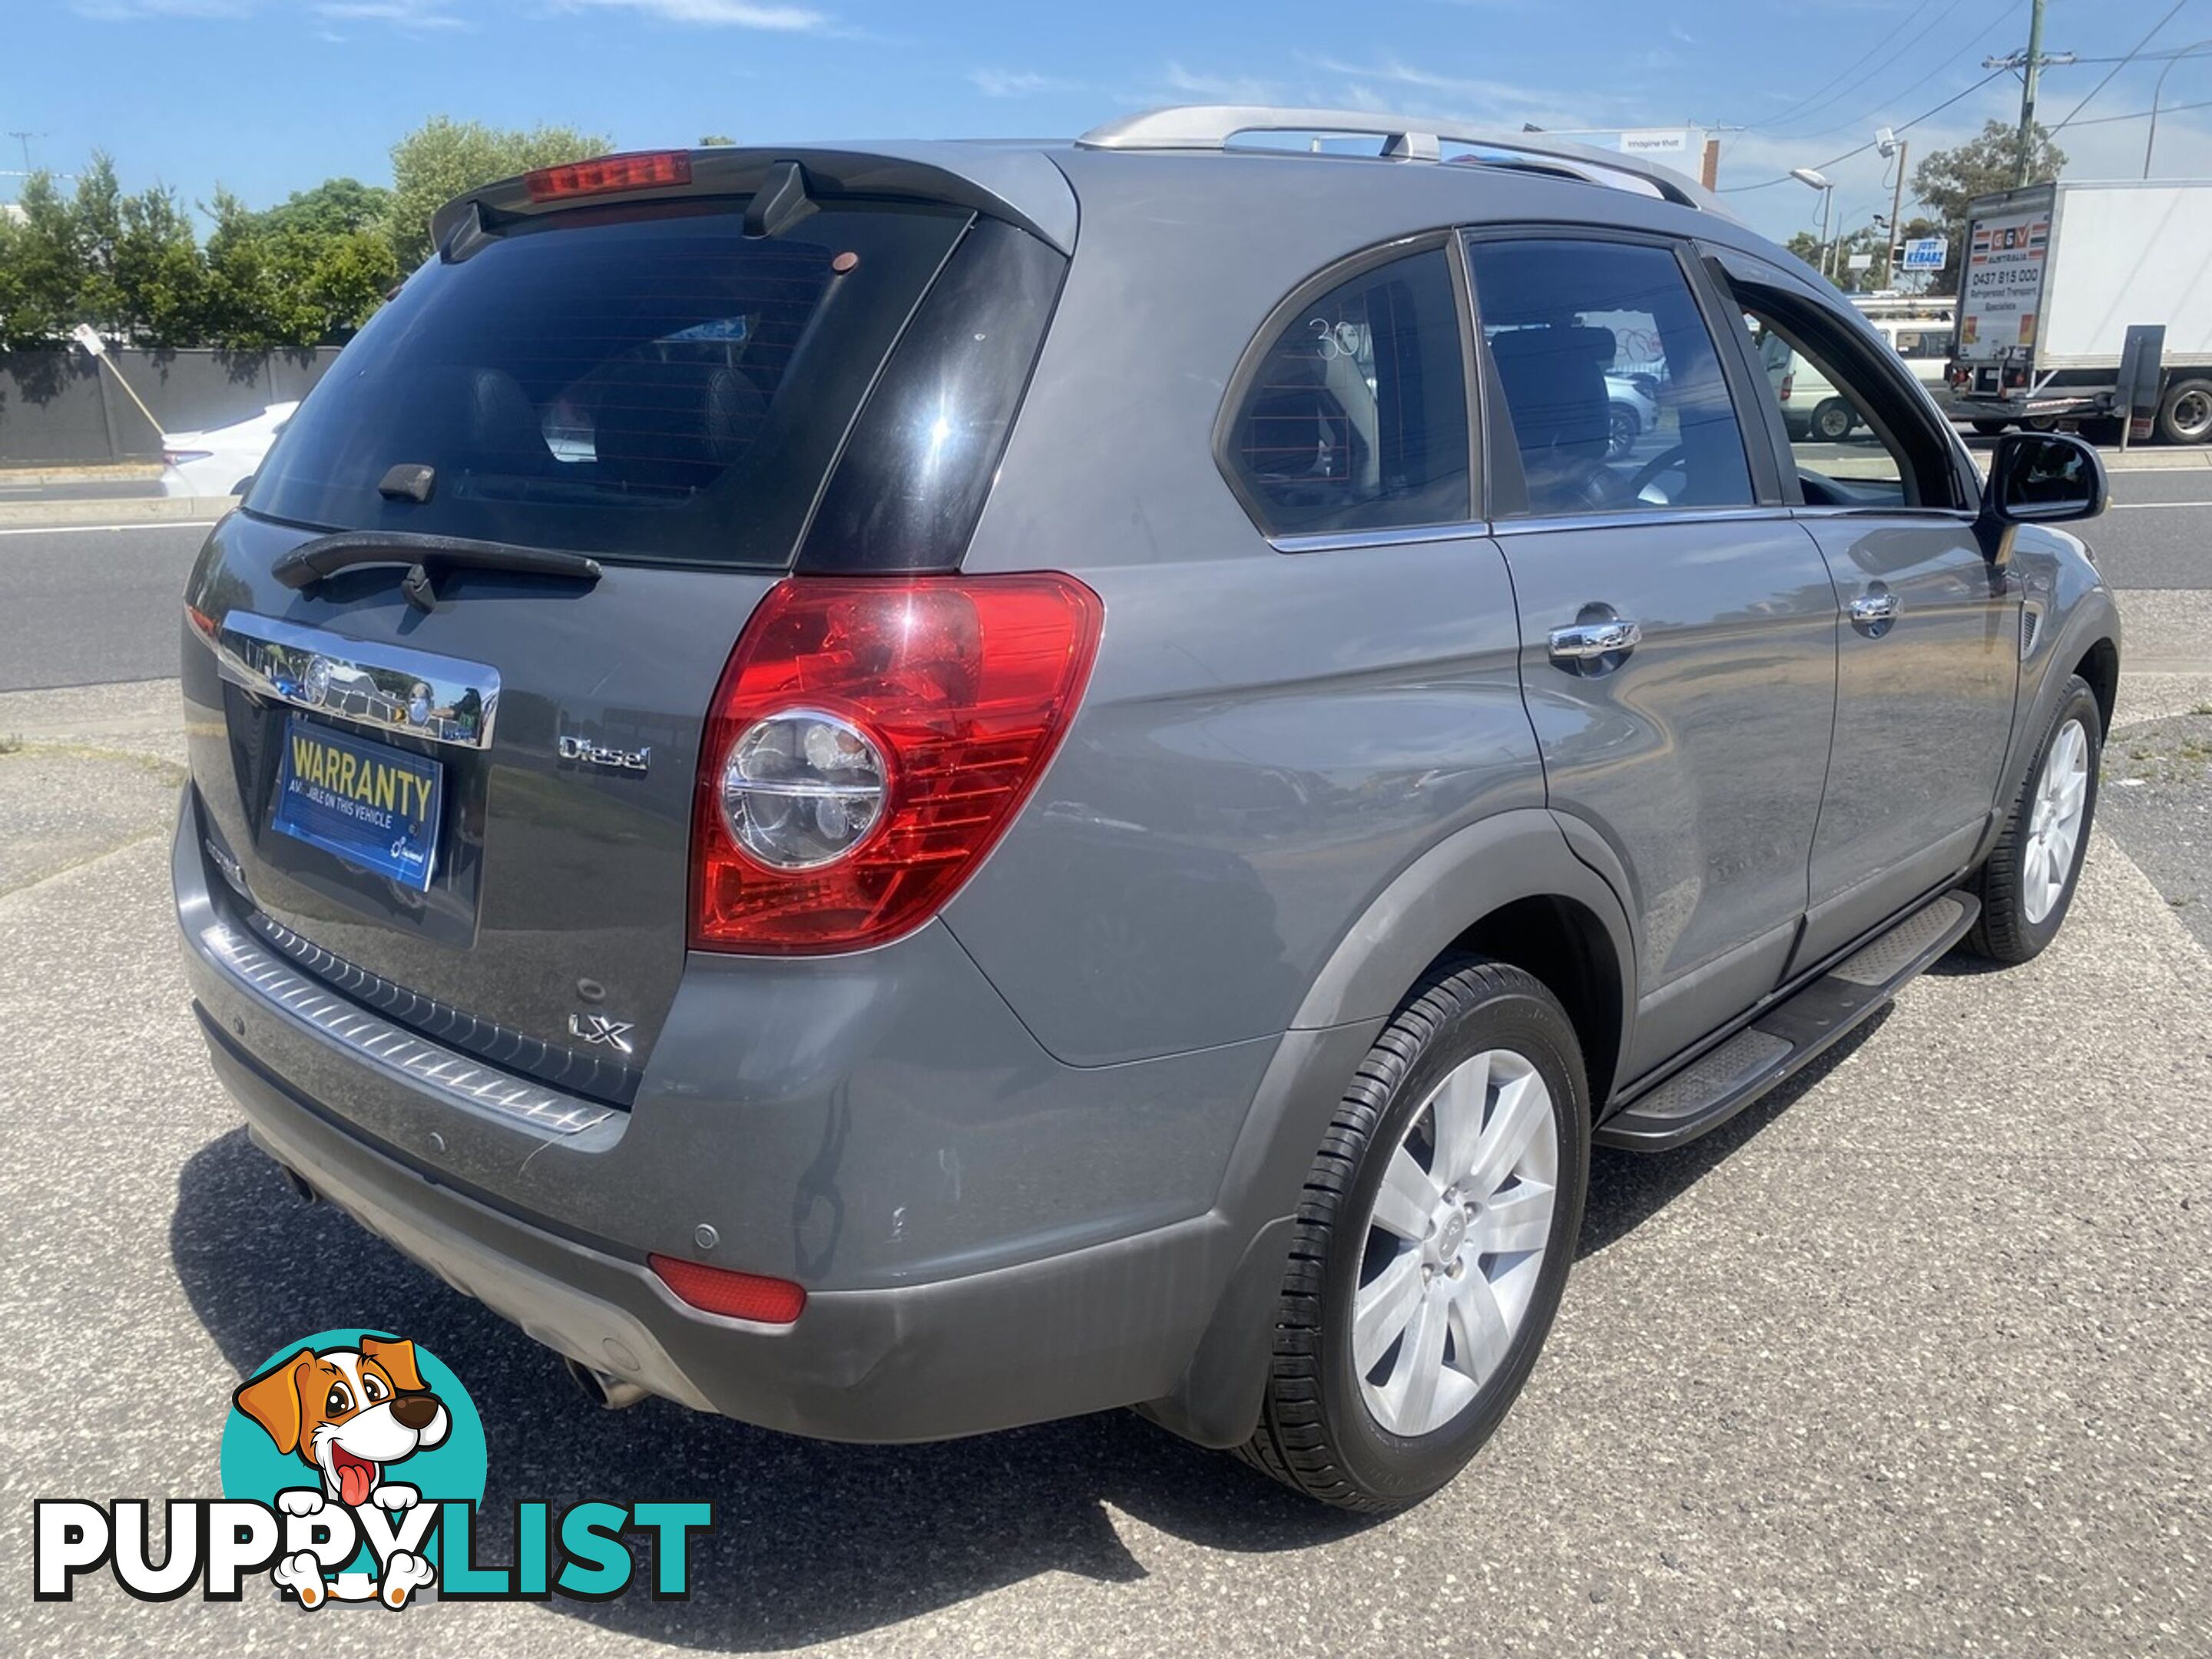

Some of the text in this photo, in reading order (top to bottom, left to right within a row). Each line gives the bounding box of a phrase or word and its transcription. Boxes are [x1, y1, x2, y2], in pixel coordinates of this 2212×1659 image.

[1917, 241, 1937, 251] JUST
[1988, 253, 2027, 263] AUSTRALIA
[1970, 286, 2036, 299] Refrigerated Transport
[1973, 269, 2038, 286] 0437 815 000
[1308, 317, 1359, 360] 30
[559, 735, 651, 770] Diesel
[293, 736, 432, 822] WARRANTY
[325, 794, 336, 810] ON
[336, 797, 354, 816] THIS
[355, 803, 392, 830] VEHICLE
[568, 1014, 634, 1054] LX
